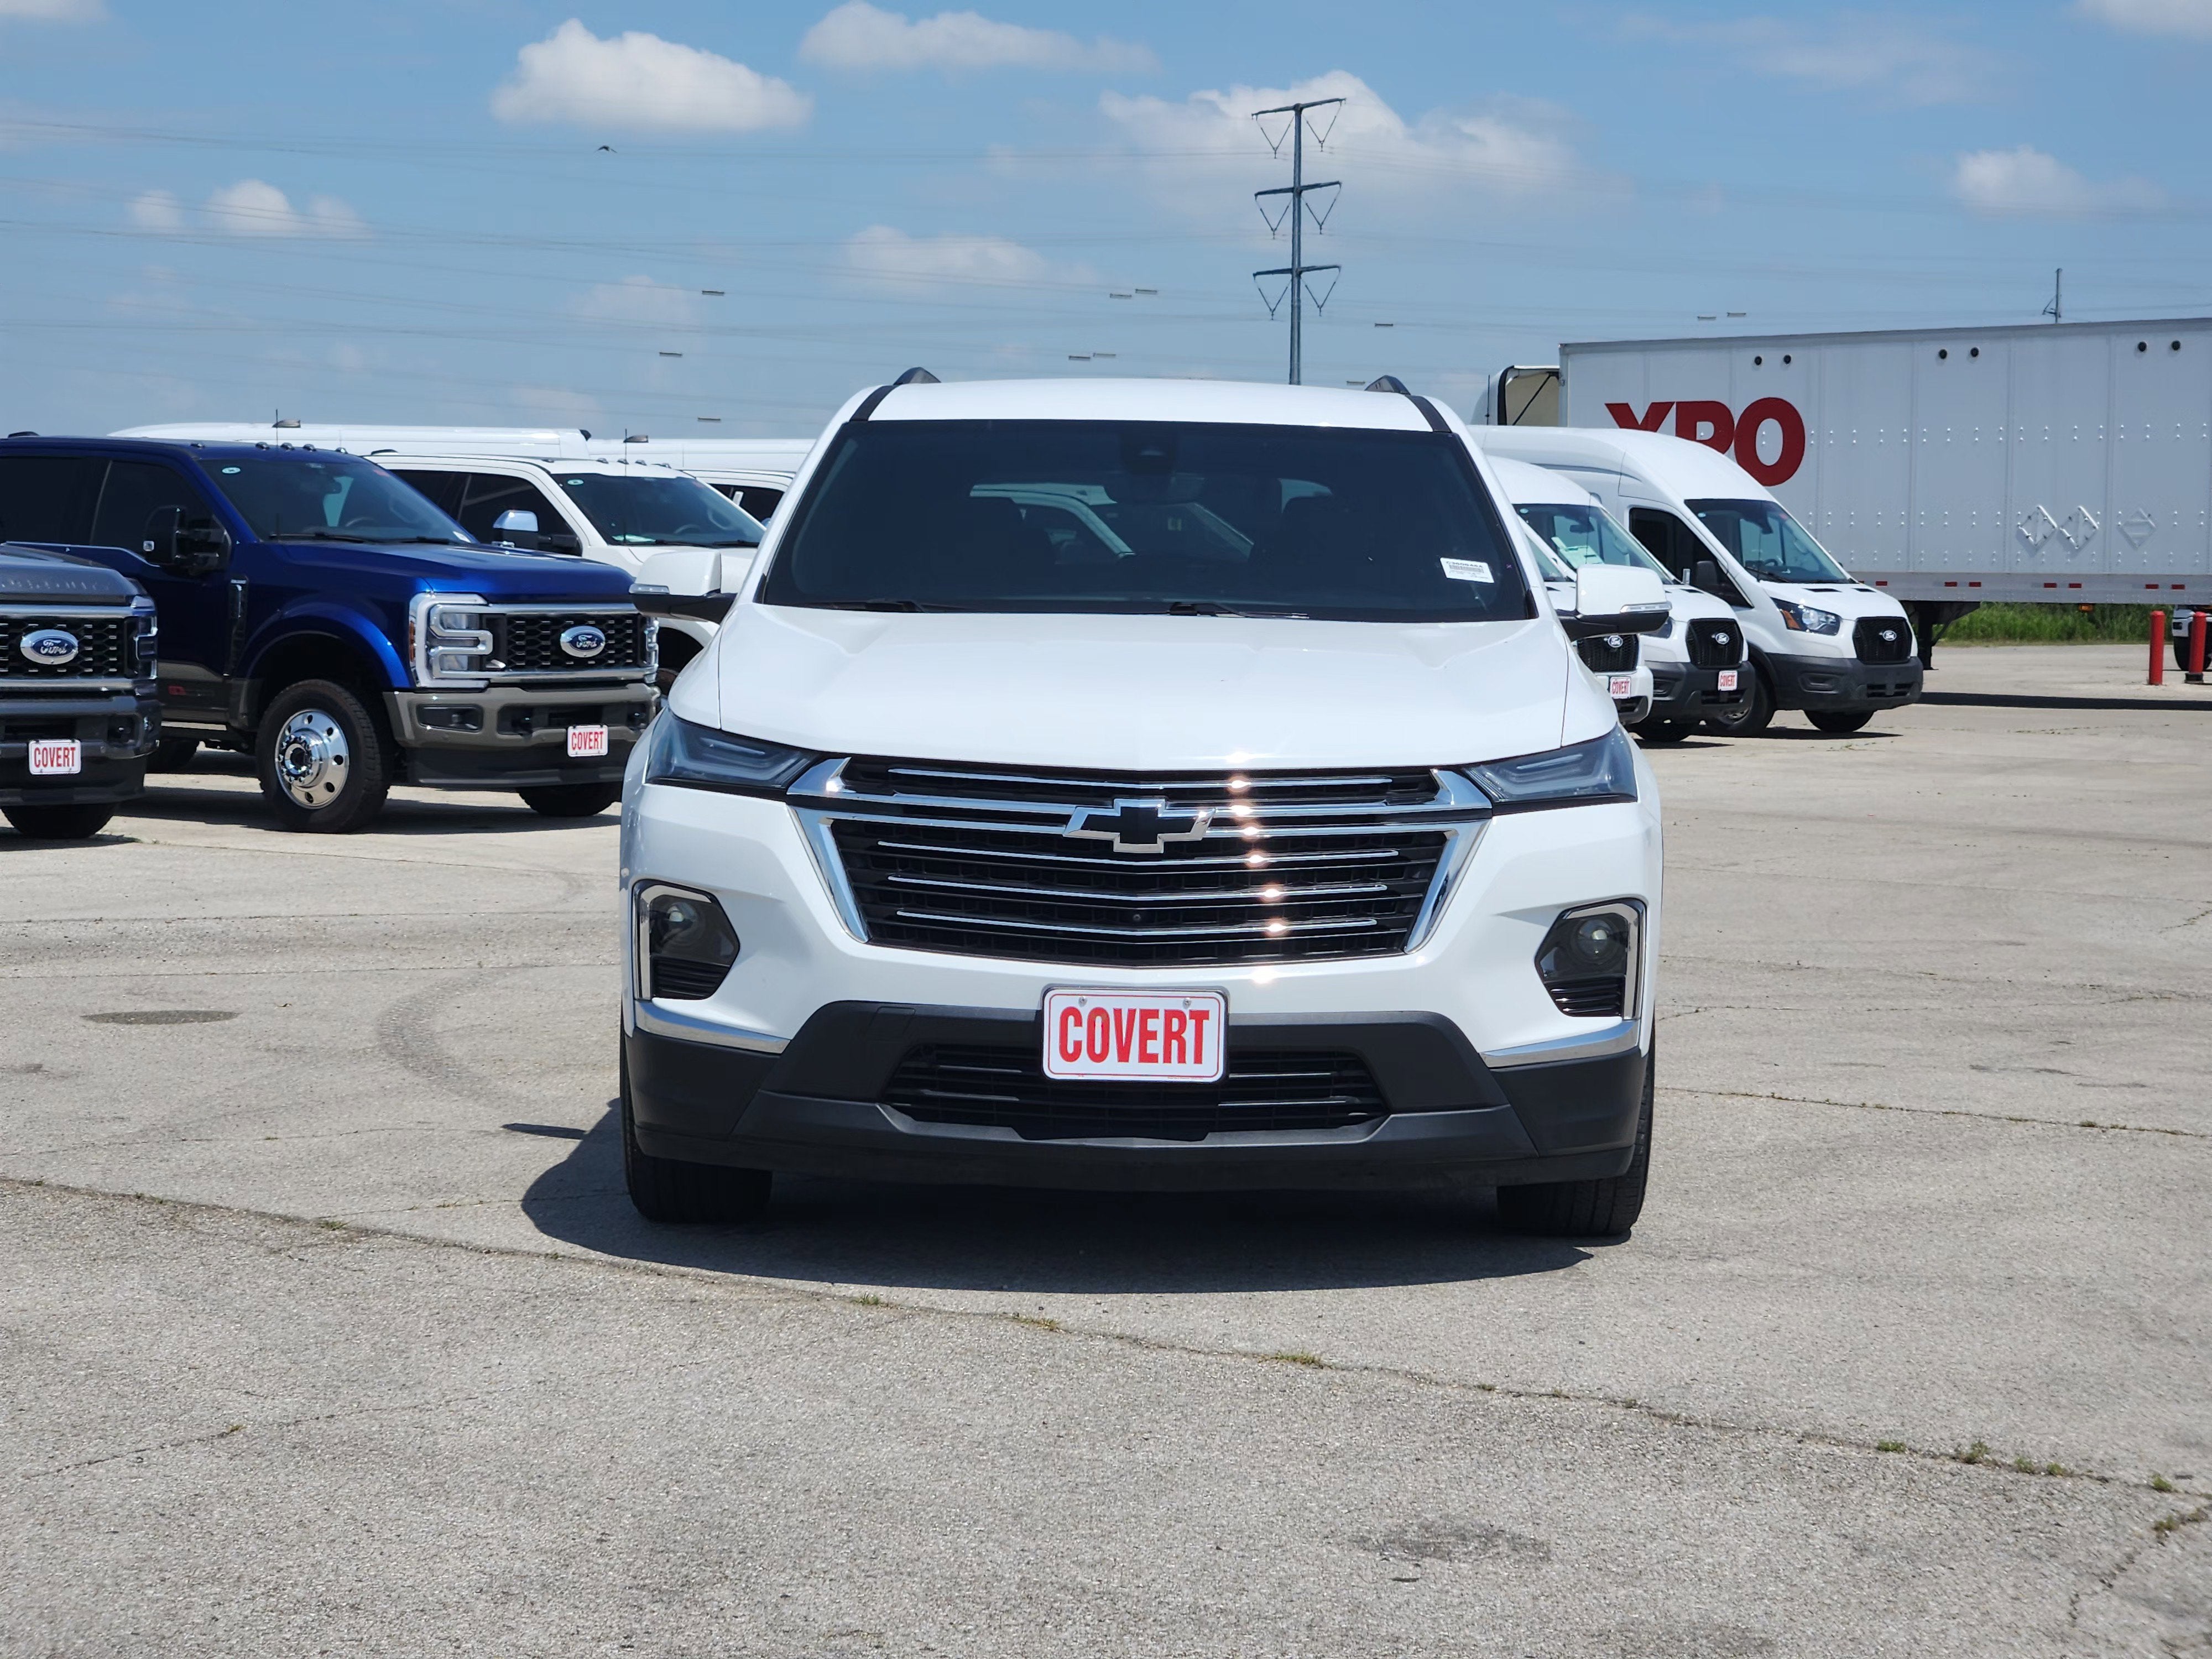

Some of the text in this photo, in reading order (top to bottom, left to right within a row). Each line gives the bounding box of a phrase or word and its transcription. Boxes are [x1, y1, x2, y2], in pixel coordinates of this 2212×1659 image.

[40, 639, 67, 654] Ford
[571, 731, 604, 750] COVERT
[34, 747, 76, 768] COVERT
[1058, 1006, 1211, 1065] COVERT
